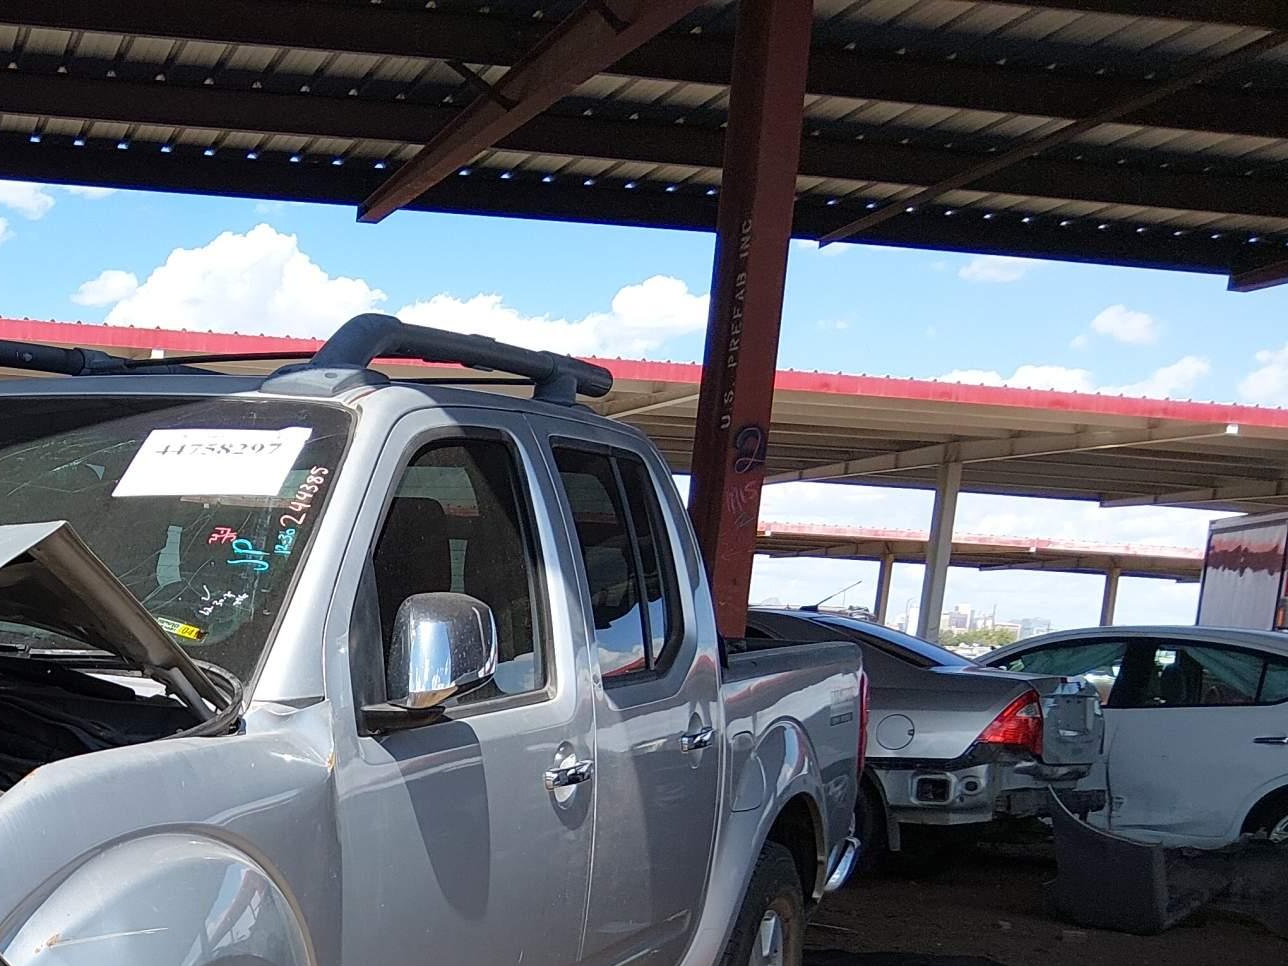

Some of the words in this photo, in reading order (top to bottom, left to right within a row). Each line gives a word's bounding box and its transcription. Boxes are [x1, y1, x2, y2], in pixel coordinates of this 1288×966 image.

[727, 272, 747, 369] PREFAB
[279, 465, 329, 528] 244385
[227, 538, 271, 571] JP
